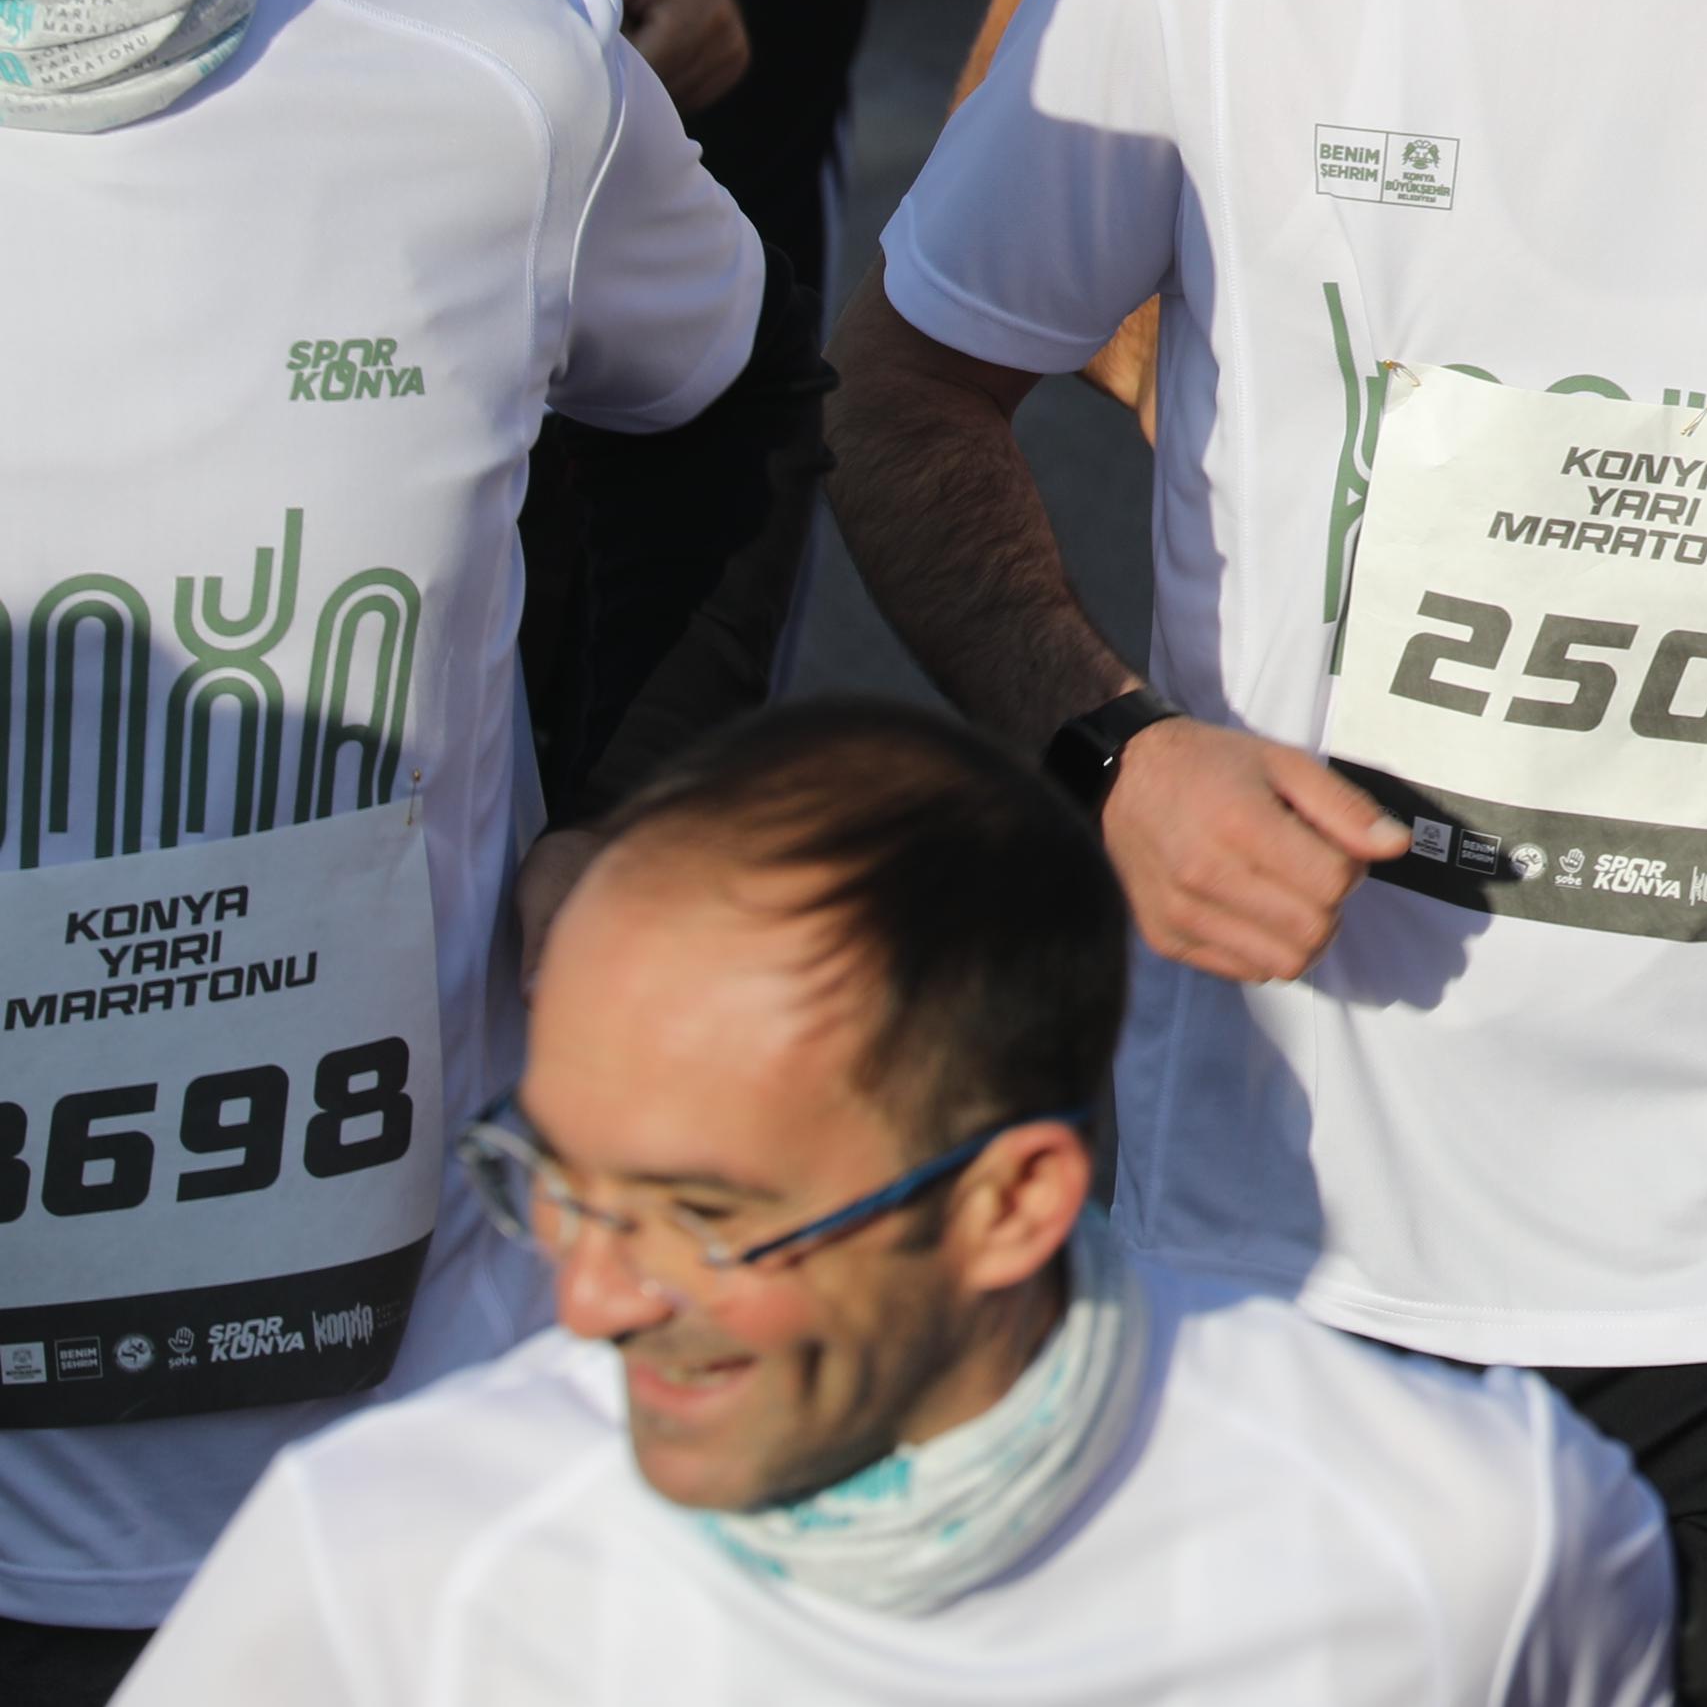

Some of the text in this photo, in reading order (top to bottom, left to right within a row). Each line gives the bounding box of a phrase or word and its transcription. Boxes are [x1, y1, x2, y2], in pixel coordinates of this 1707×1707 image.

[288, 338, 398, 372] SPOR
[289, 359, 426, 402] KONYA
[1587, 485, 1701, 527] YARI
[1554, 874, 1582, 885] sobe
[1594, 854, 1667, 880] SPOR
[1592, 870, 1681, 899] KONYA
[65, 885, 249, 945] KONYA
[99, 930, 223, 978] YARI
[3, 951, 319, 1032] MARATONU
[208, 1316, 283, 1344] SPOR
[168, 1354, 197, 1370] sobe
[210, 1331, 305, 1362] KONYA
